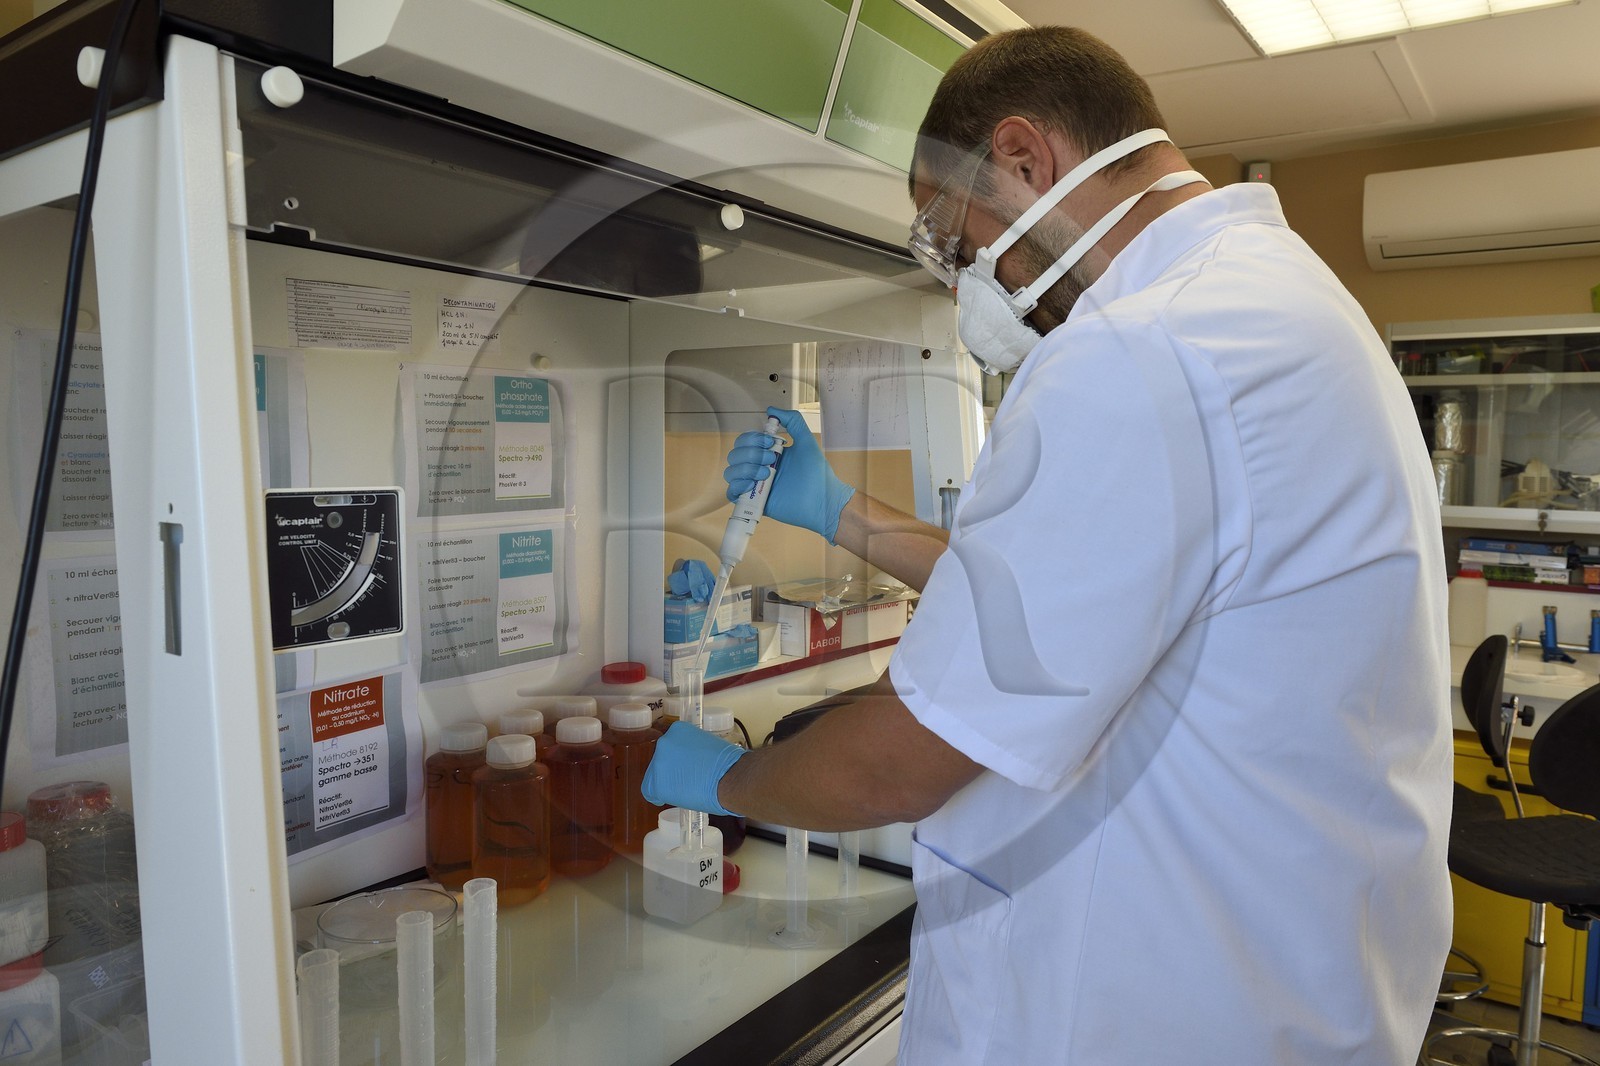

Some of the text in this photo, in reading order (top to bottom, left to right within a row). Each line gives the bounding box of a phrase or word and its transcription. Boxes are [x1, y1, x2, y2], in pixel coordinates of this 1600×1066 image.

[440, 374, 469, 383] échantillon
[510, 379, 533, 389] Ortho
[500, 393, 542, 402] phosphate
[62, 407, 89, 415] oucher
[498, 455, 523, 463] Spectro
[512, 535, 541, 547] Nitrite
[501, 600, 532, 610] Méthode
[501, 609, 527, 618] Spectro
[66, 618, 103, 628] Secouer
[67, 624, 104, 637] pendant
[811, 636, 842, 650] LABOR
[69, 651, 97, 661] Laisser
[71, 672, 119, 686] Blanc avec
[323, 684, 371, 706] Nitrate
[73, 710, 92, 719] Zero
[94, 706, 116, 716] avec
[318, 698, 377, 719] Méthode de réduction
[339, 708, 365, 719] cadmium
[73, 716, 103, 728] lecture
[293, 755, 309, 765] autre
[319, 742, 378, 766] Méthode 8192
[318, 754, 376, 777] Spectro 351
[318, 763, 378, 788] gamme basse
[700, 859, 712, 872] BN
[699, 871, 718, 888] 05/15
